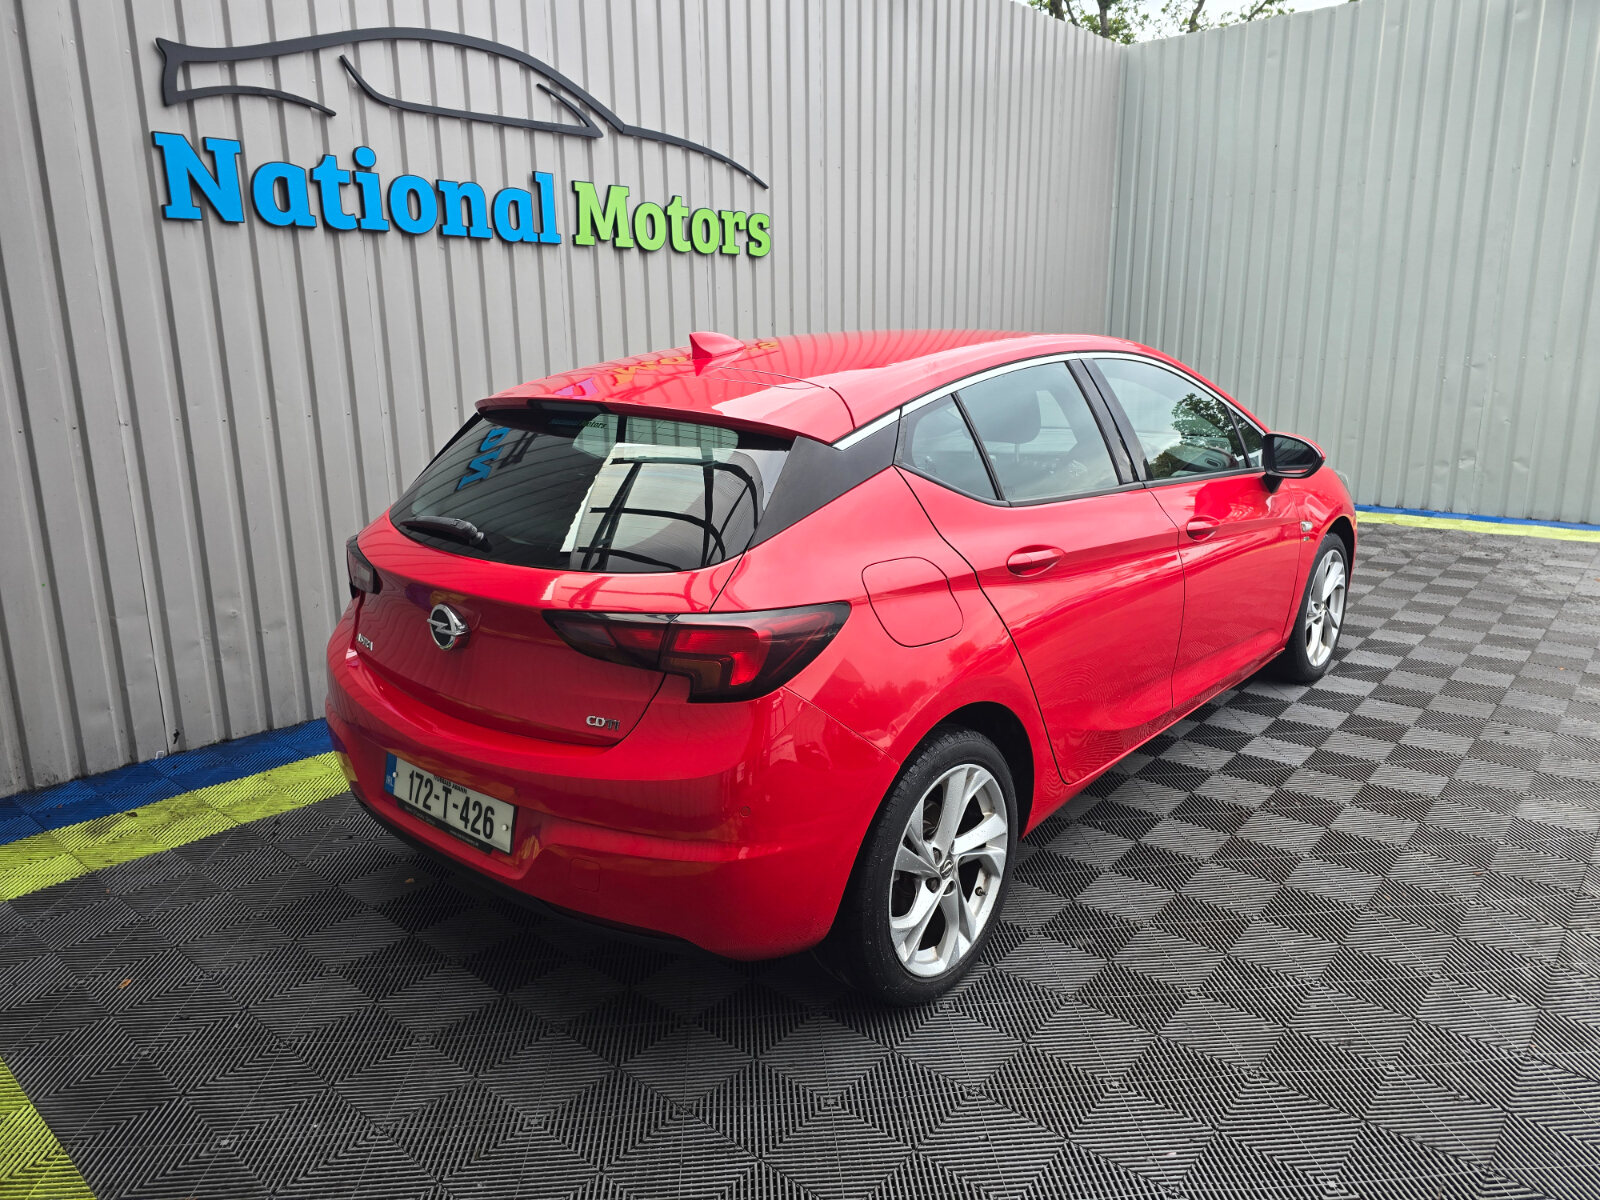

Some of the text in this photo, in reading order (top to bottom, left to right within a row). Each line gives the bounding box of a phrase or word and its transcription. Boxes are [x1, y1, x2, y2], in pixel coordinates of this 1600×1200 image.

[151, 131, 771, 257] National Motors
[409, 769, 495, 840] 172-T-426
